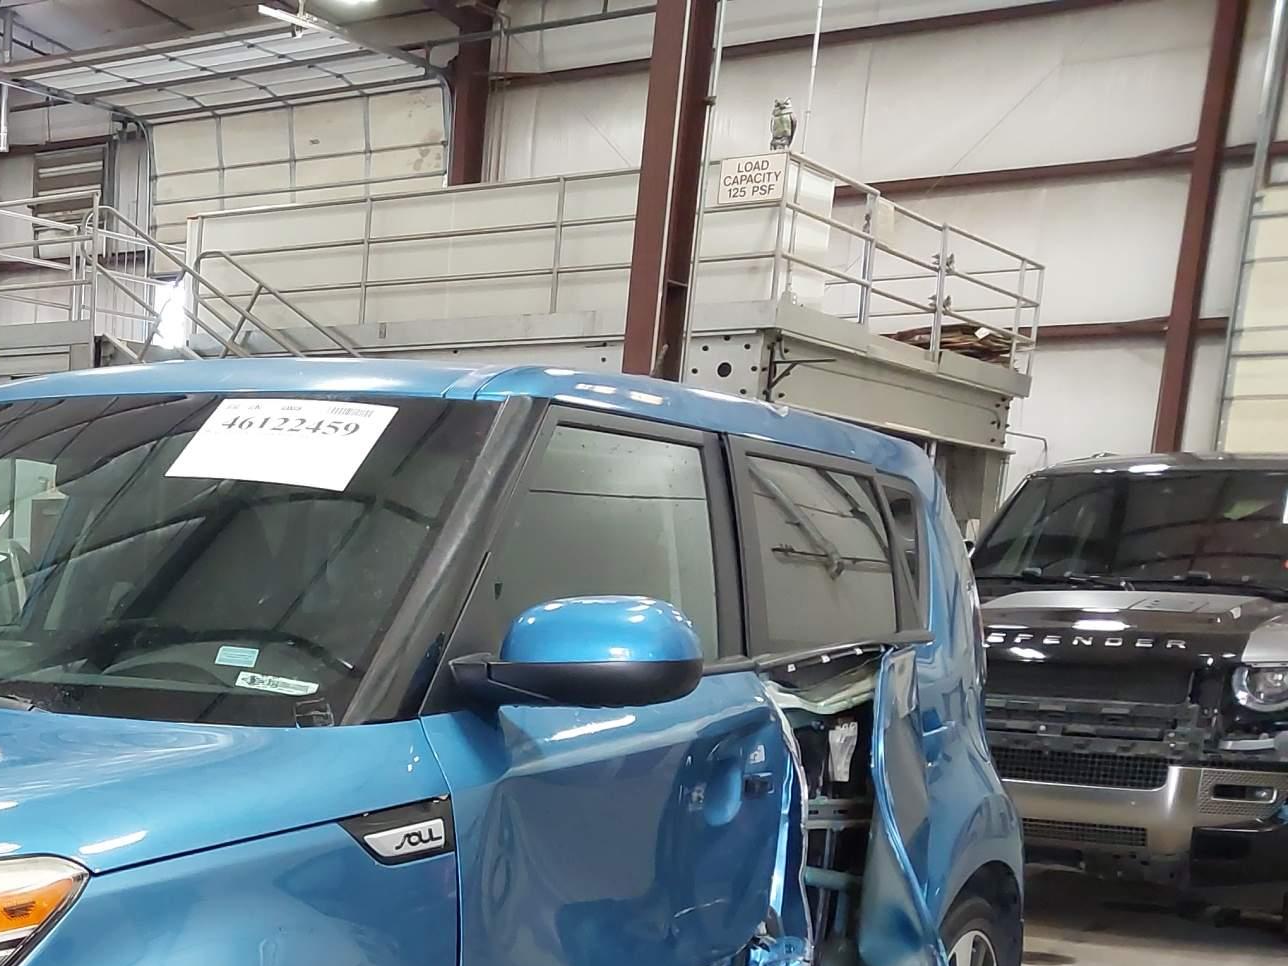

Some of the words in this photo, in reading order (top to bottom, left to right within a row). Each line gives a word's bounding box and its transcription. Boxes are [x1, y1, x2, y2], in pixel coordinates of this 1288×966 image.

[737, 159, 770, 173] LOAD
[723, 170, 782, 187] CAPACITY
[727, 188, 747, 199] 125
[751, 184, 776, 197] PSF
[221, 415, 361, 436] 46122459
[986, 632, 1187, 650] EFENDER
[394, 828, 443, 851] SOUL
